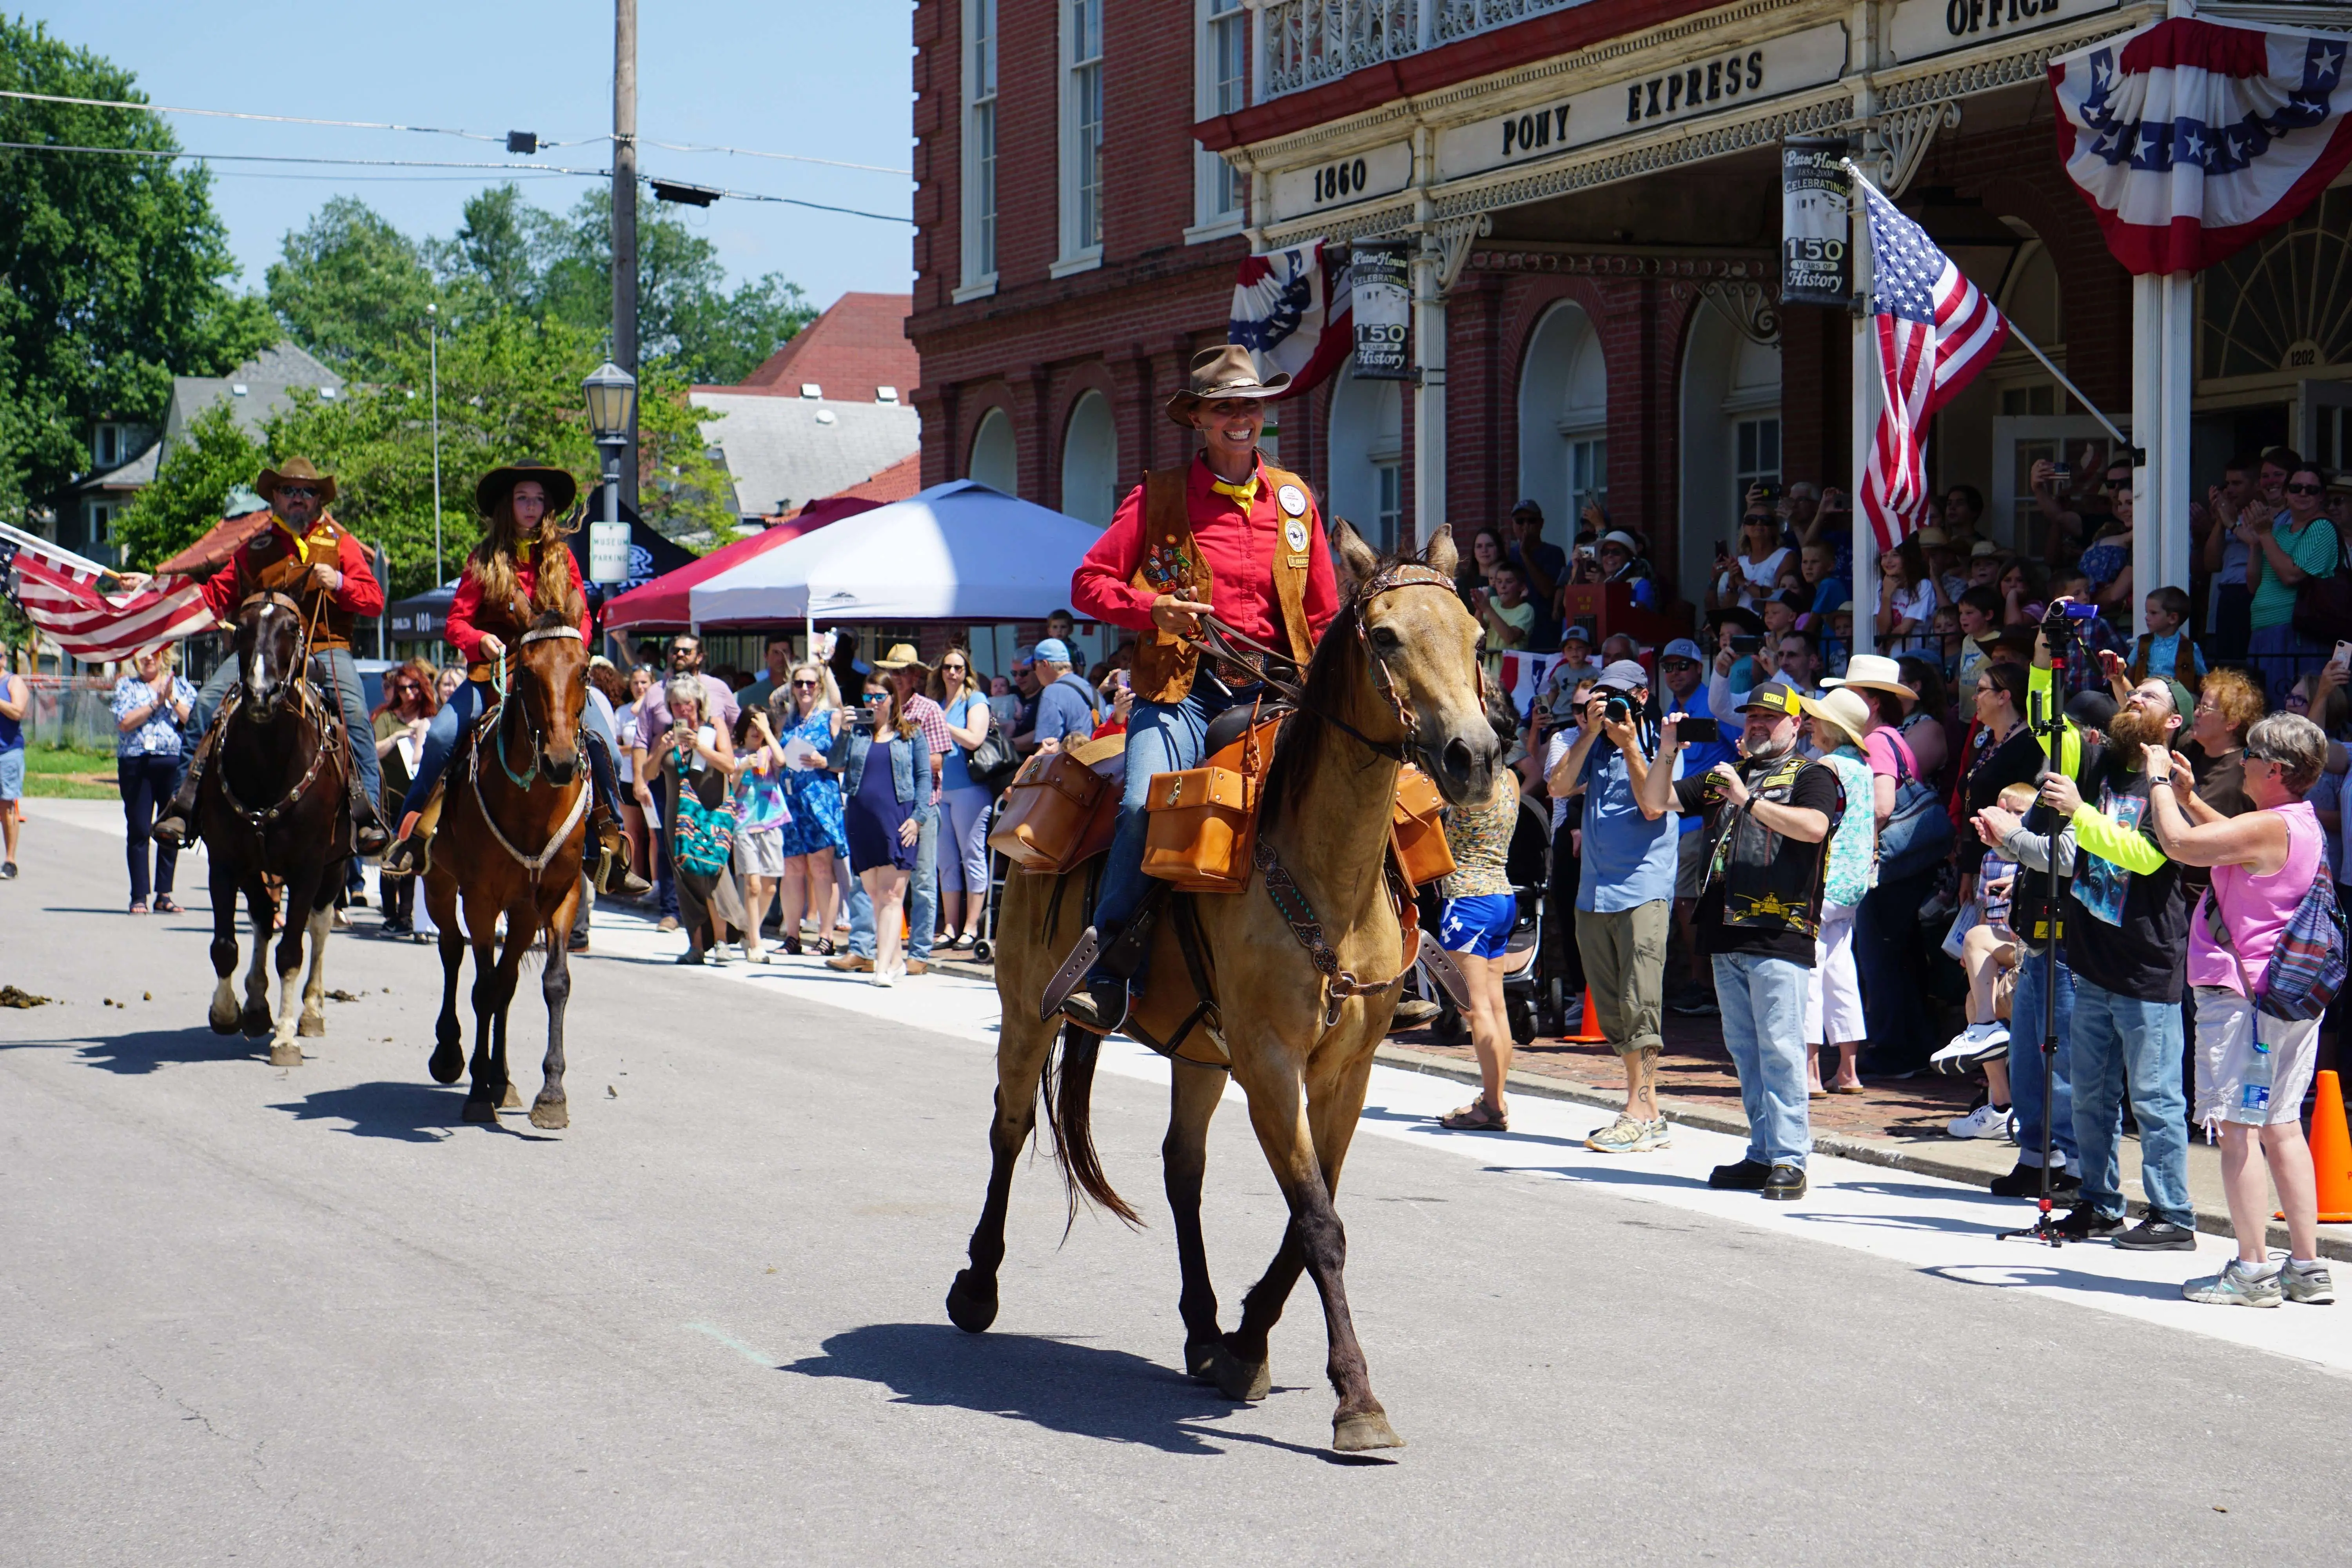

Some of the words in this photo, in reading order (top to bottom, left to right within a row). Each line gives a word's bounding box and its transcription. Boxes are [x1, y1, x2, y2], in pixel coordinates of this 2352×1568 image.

[1502, 103, 1570, 155] PONY
[1626, 51, 1762, 122] EXPRESS
[1314, 158, 1366, 202] 1860
[1798, 169, 1834, 178] 1858-2008
[1784, 179, 1846, 196] CELEBRATING
[1788, 239, 1843, 261] 150
[1377, 251, 1407, 268] House
[1797, 261, 1820, 269] YEARS
[1353, 274, 1407, 288] CELEBRATING
[1788, 270, 1842, 293] History
[1356, 324, 1405, 343] 150
[1357, 351, 1405, 369] History
[2291, 349, 2315, 367] 1202
[1709, 776, 1730, 784] MUSTAN
